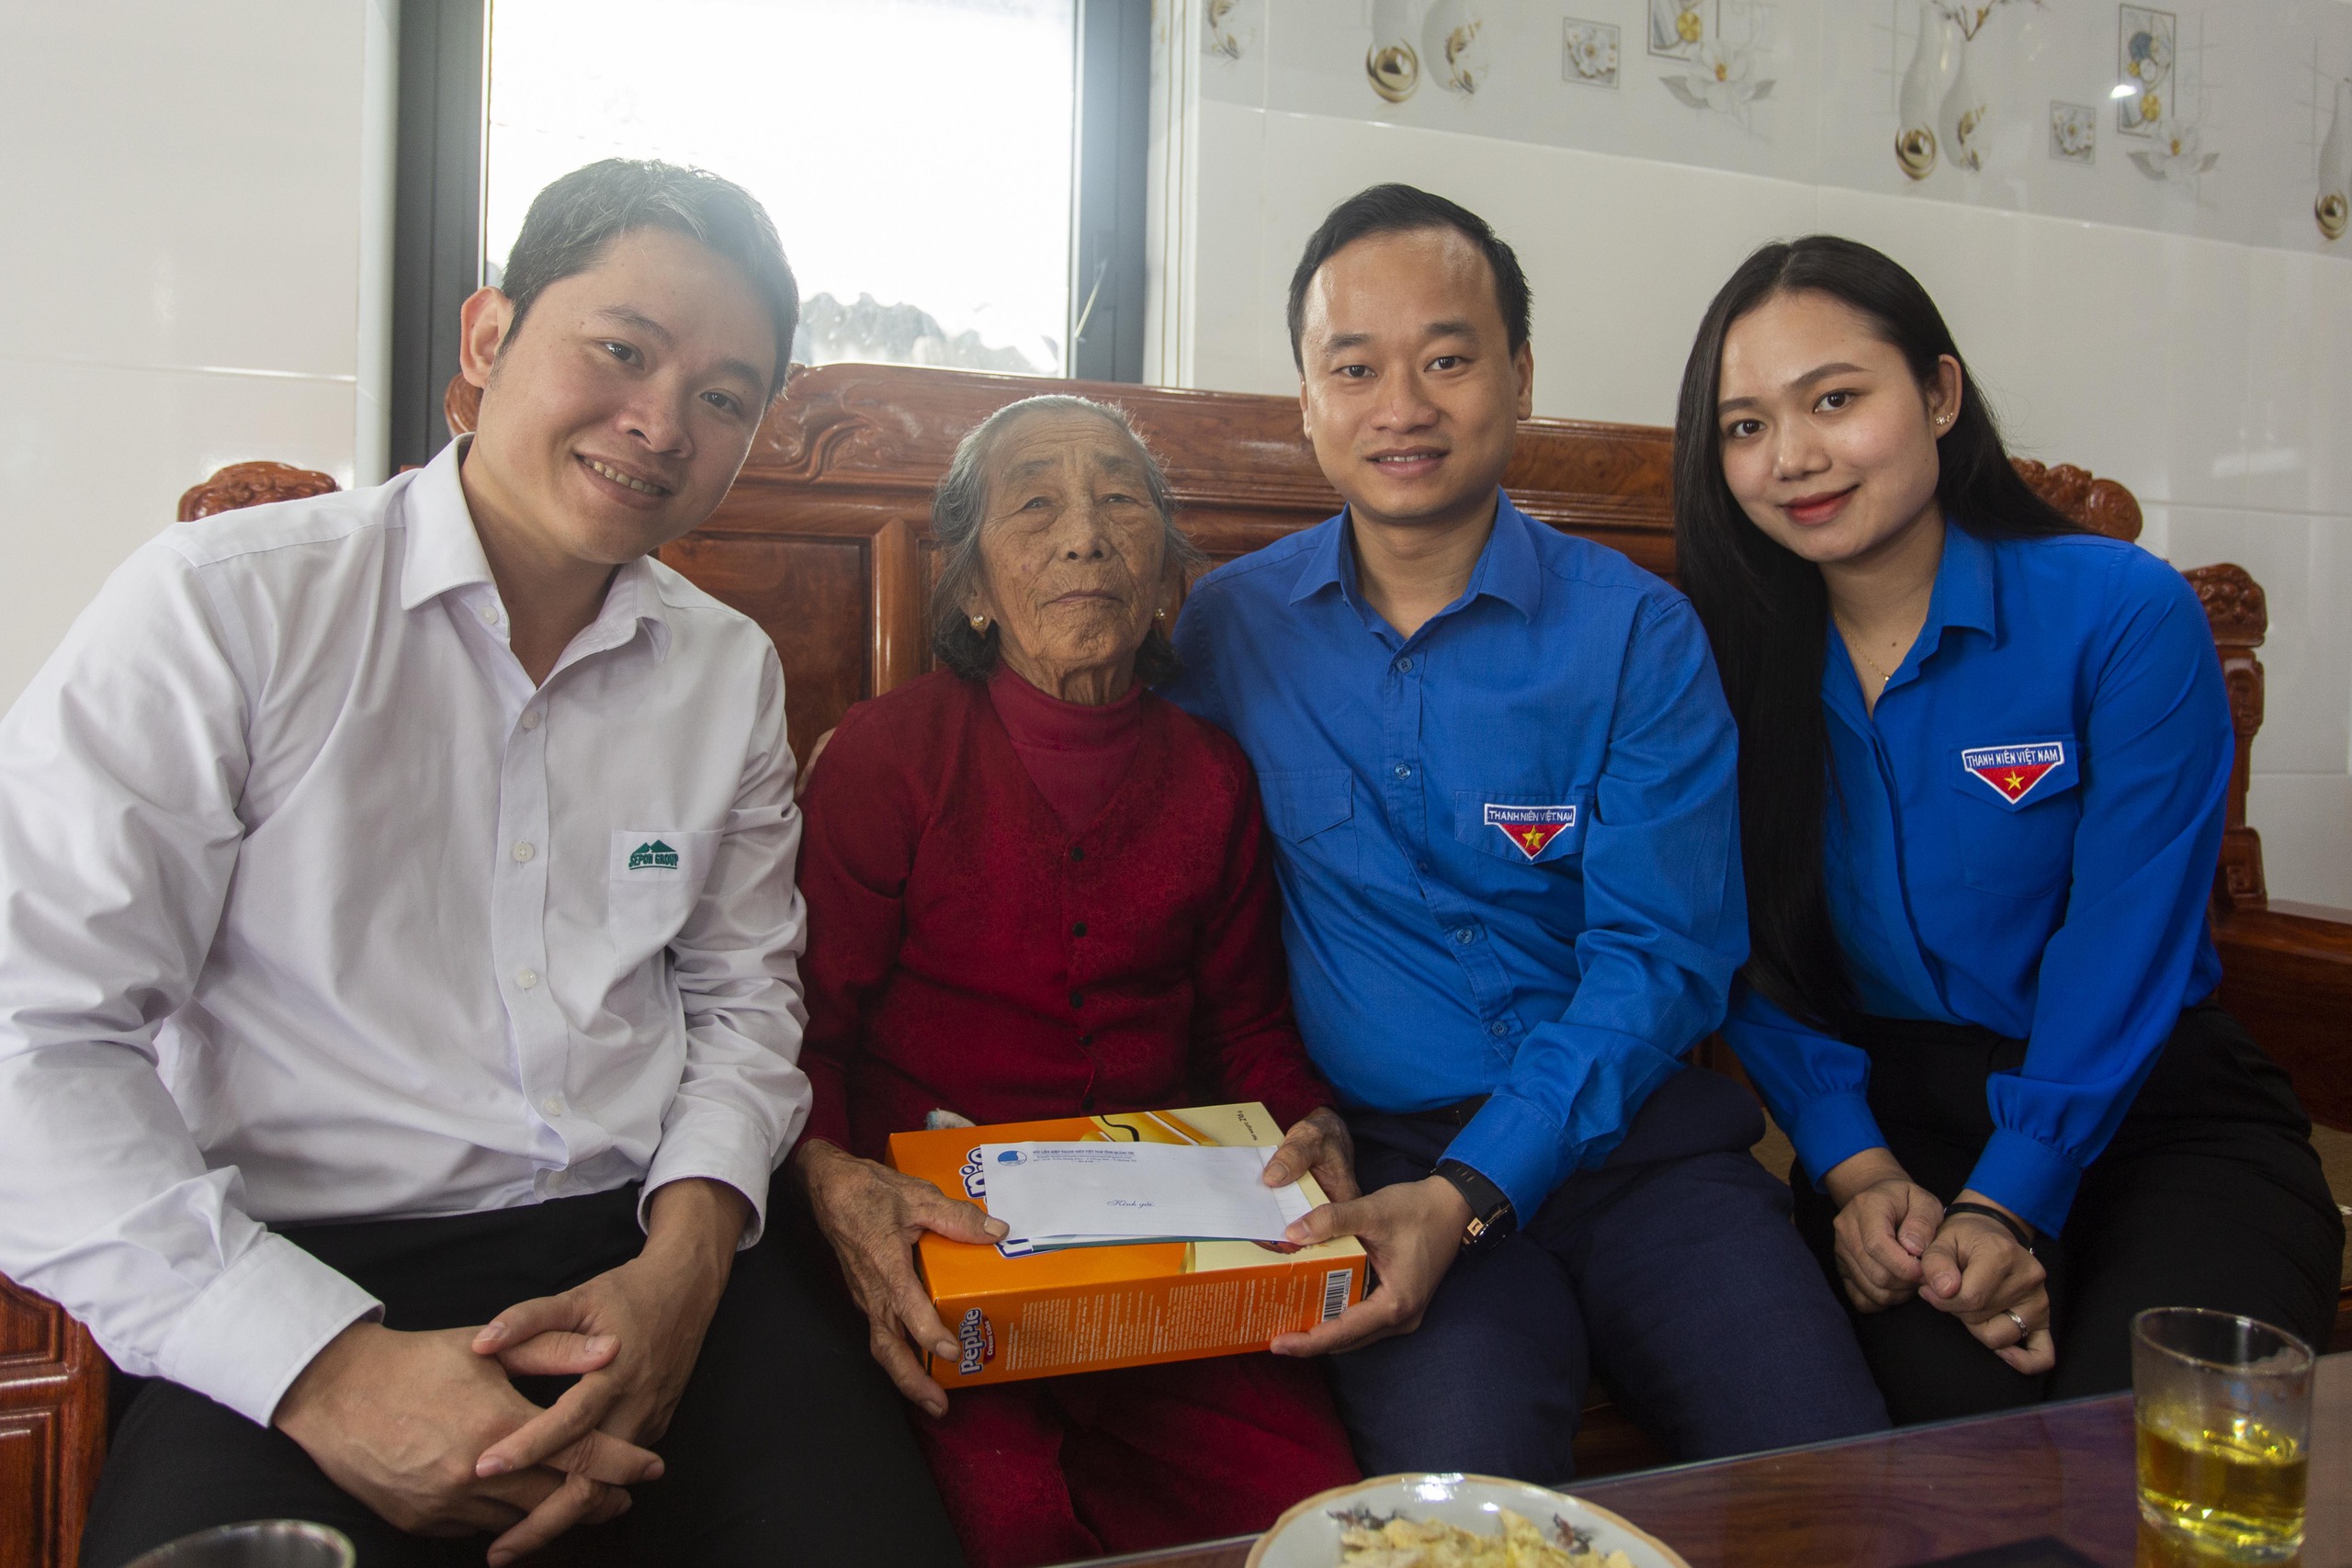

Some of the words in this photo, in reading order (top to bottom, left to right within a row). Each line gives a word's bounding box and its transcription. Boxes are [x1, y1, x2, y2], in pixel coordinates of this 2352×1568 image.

[1966, 753, 1995, 767] THANH
[1996, 750, 2017, 765] NIÊN
[2017, 748, 2037, 765] VIỆT
[2038, 749, 2059, 761] NAM
[1488, 810, 1520, 821] THANH
[1520, 809, 1539, 822] NIÊN
[1540, 809, 1556, 823] VIỆT
[1556, 811, 1573, 821] NAM
[628, 853, 653, 867] SEPON
[655, 853, 678, 866] GROUP
[958, 1308, 986, 1375] PepPie
